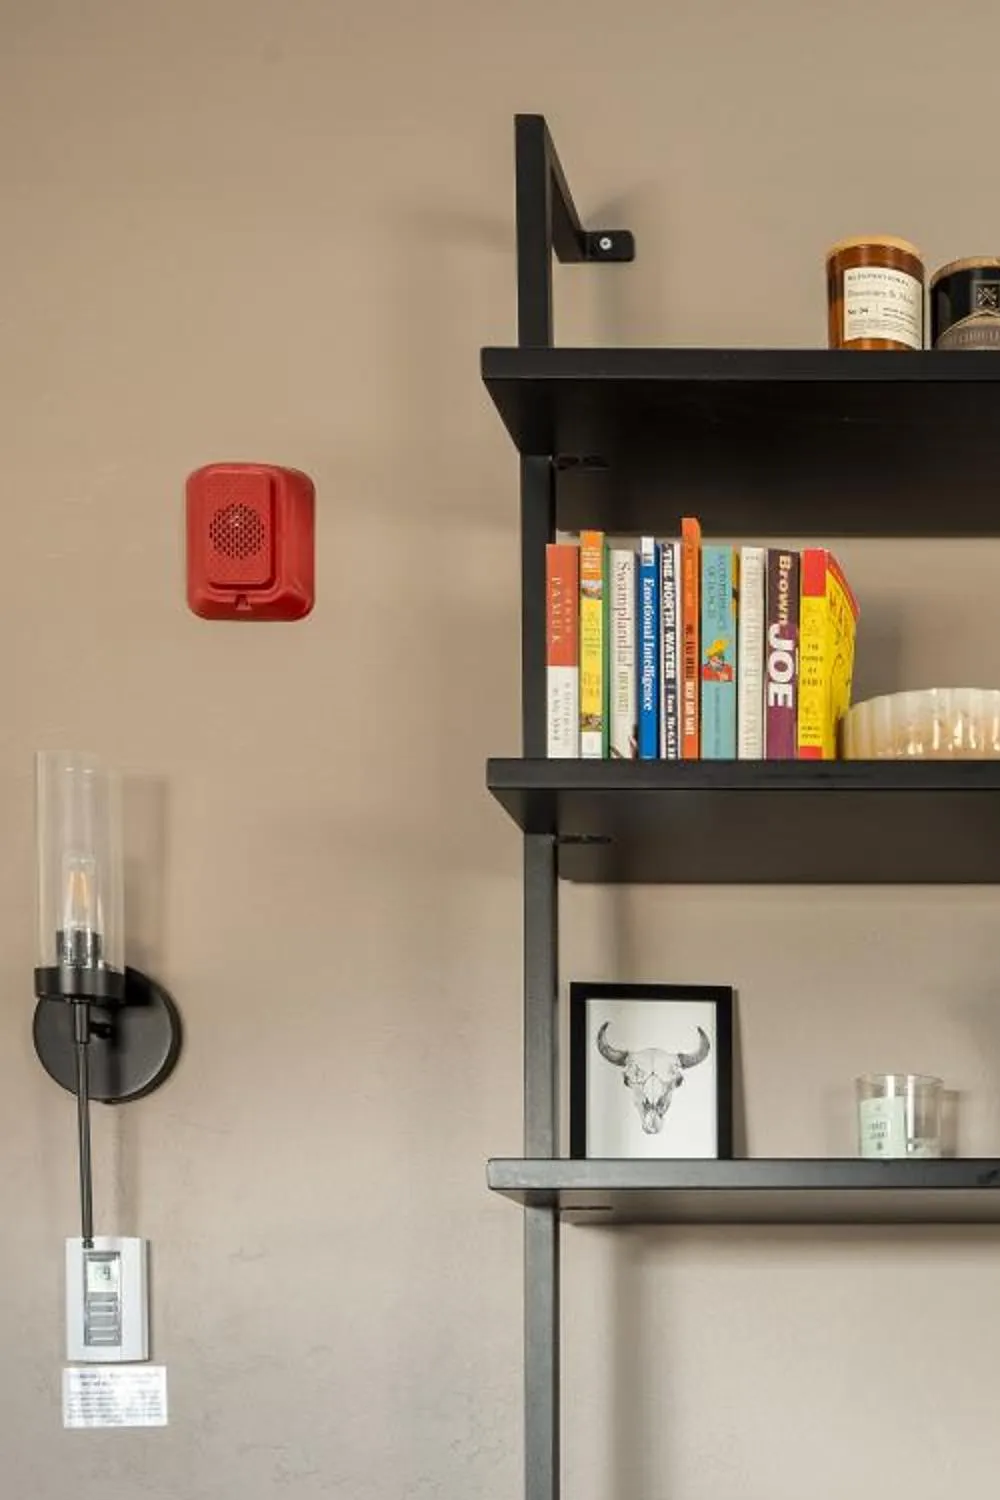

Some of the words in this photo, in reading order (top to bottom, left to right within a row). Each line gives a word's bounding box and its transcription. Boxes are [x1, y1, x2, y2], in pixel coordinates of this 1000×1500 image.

[663, 550, 673, 578] THE
[778, 555, 791, 626] Brown
[643, 577, 655, 639] Emotional
[664, 581, 675, 627] NORTH
[643, 642, 656, 710] Intelligence
[665, 631, 676, 679] WATER
[768, 623, 795, 708] JOE
